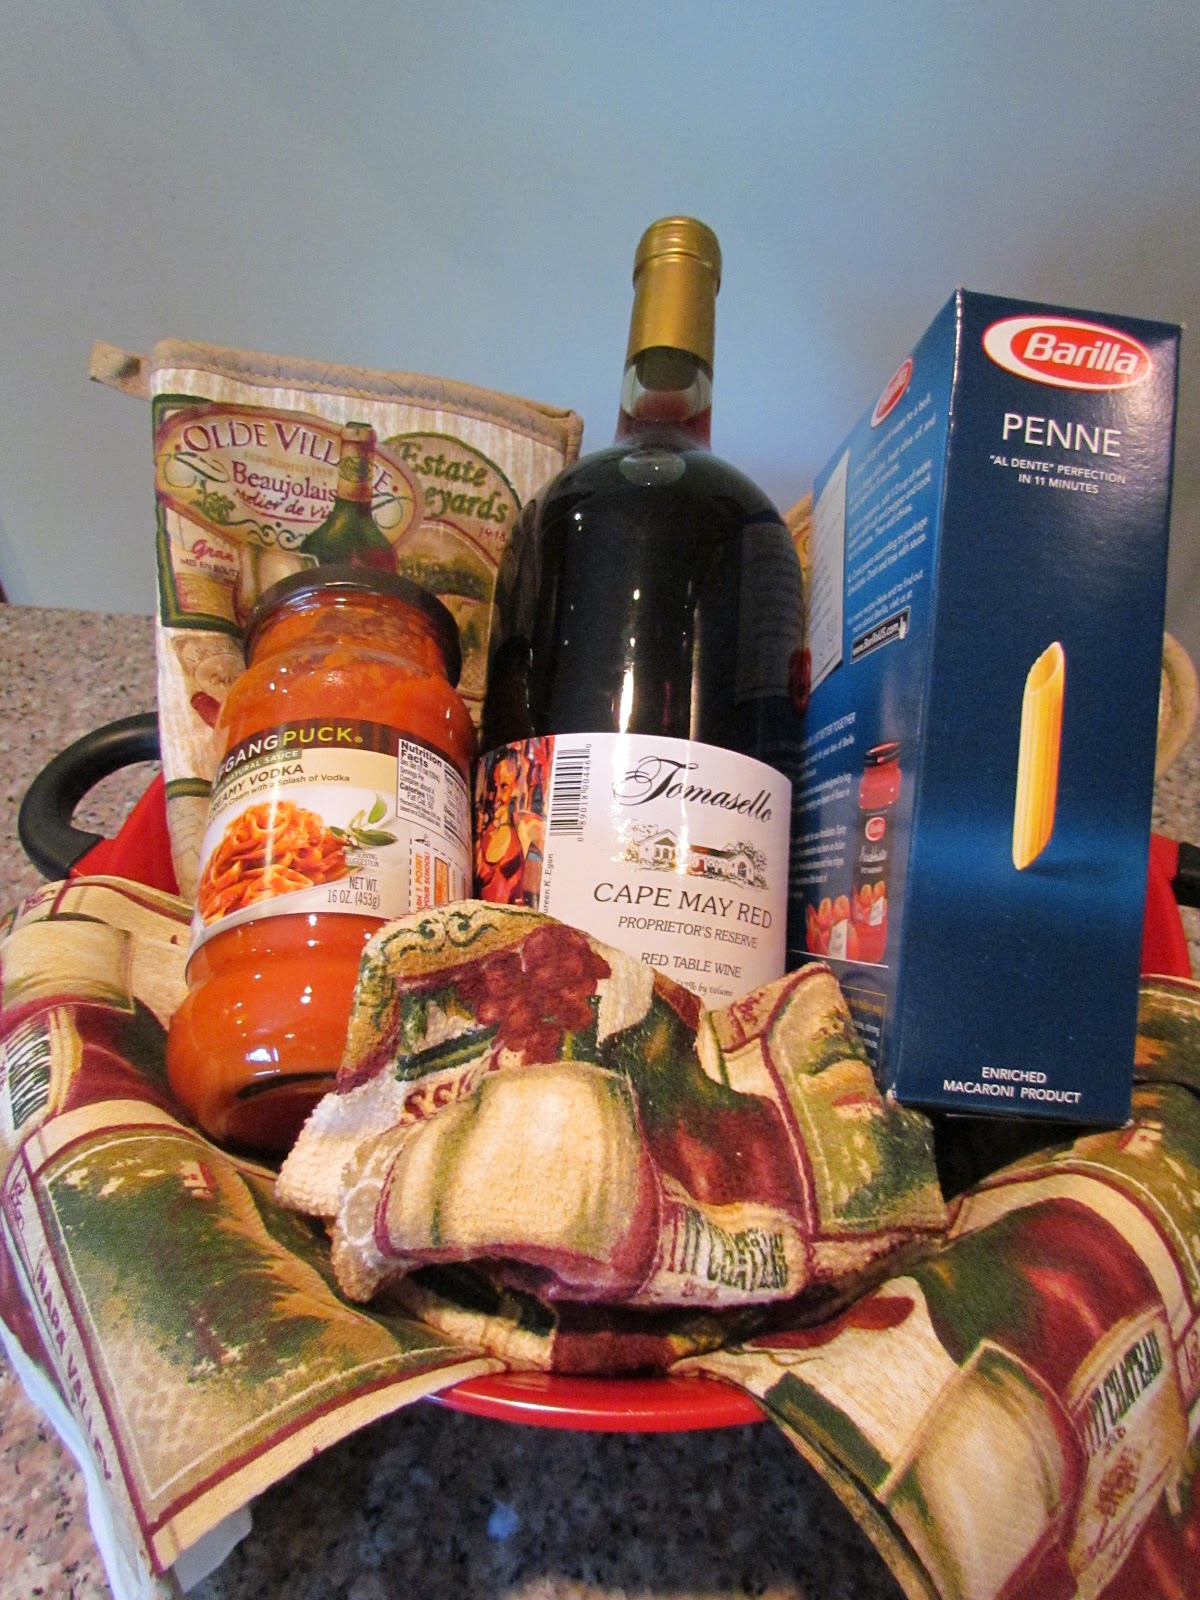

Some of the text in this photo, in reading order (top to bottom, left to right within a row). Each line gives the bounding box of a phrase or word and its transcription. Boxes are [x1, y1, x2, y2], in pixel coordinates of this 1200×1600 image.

[1022, 331, 1139, 375] Barilla
[183, 421, 268, 452] OLDE
[1002, 412, 1122, 458] PENNE
[399, 441, 488, 488] Estate
[1057, 465, 1127, 485] PERFECTION
[232, 460, 339, 503] Beaujolais
[1018, 473, 1099, 494] IN 11 MINUTES
[401, 740, 442, 768] Nutrition
[401, 749, 429, 768] Facts
[226, 750, 299, 785] NATURAL SAUCE
[250, 763, 304, 786] VODKA
[251, 783, 268, 796] with
[277, 776, 306, 787] Splash
[308, 774, 319, 782] of
[321, 773, 350, 782] Vodka
[400, 782, 425, 798] Calories
[611, 755, 773, 824] Tomasello
[355, 850, 378, 860] SERVING
[545, 853, 554, 876] Egan
[349, 875, 379, 892] NET WT.
[328, 889, 338, 903] 16
[355, 891, 380, 910] (453g)
[593, 881, 773, 930] CAPE MAY RED
[618, 915, 758, 950] PROPRIETOR'S RESERVE
[641, 952, 742, 978] RED TABLE WINE
[981, 1065, 1047, 1085] ENRICHED
[942, 1079, 1082, 1105] MACARONI PRODUCT
